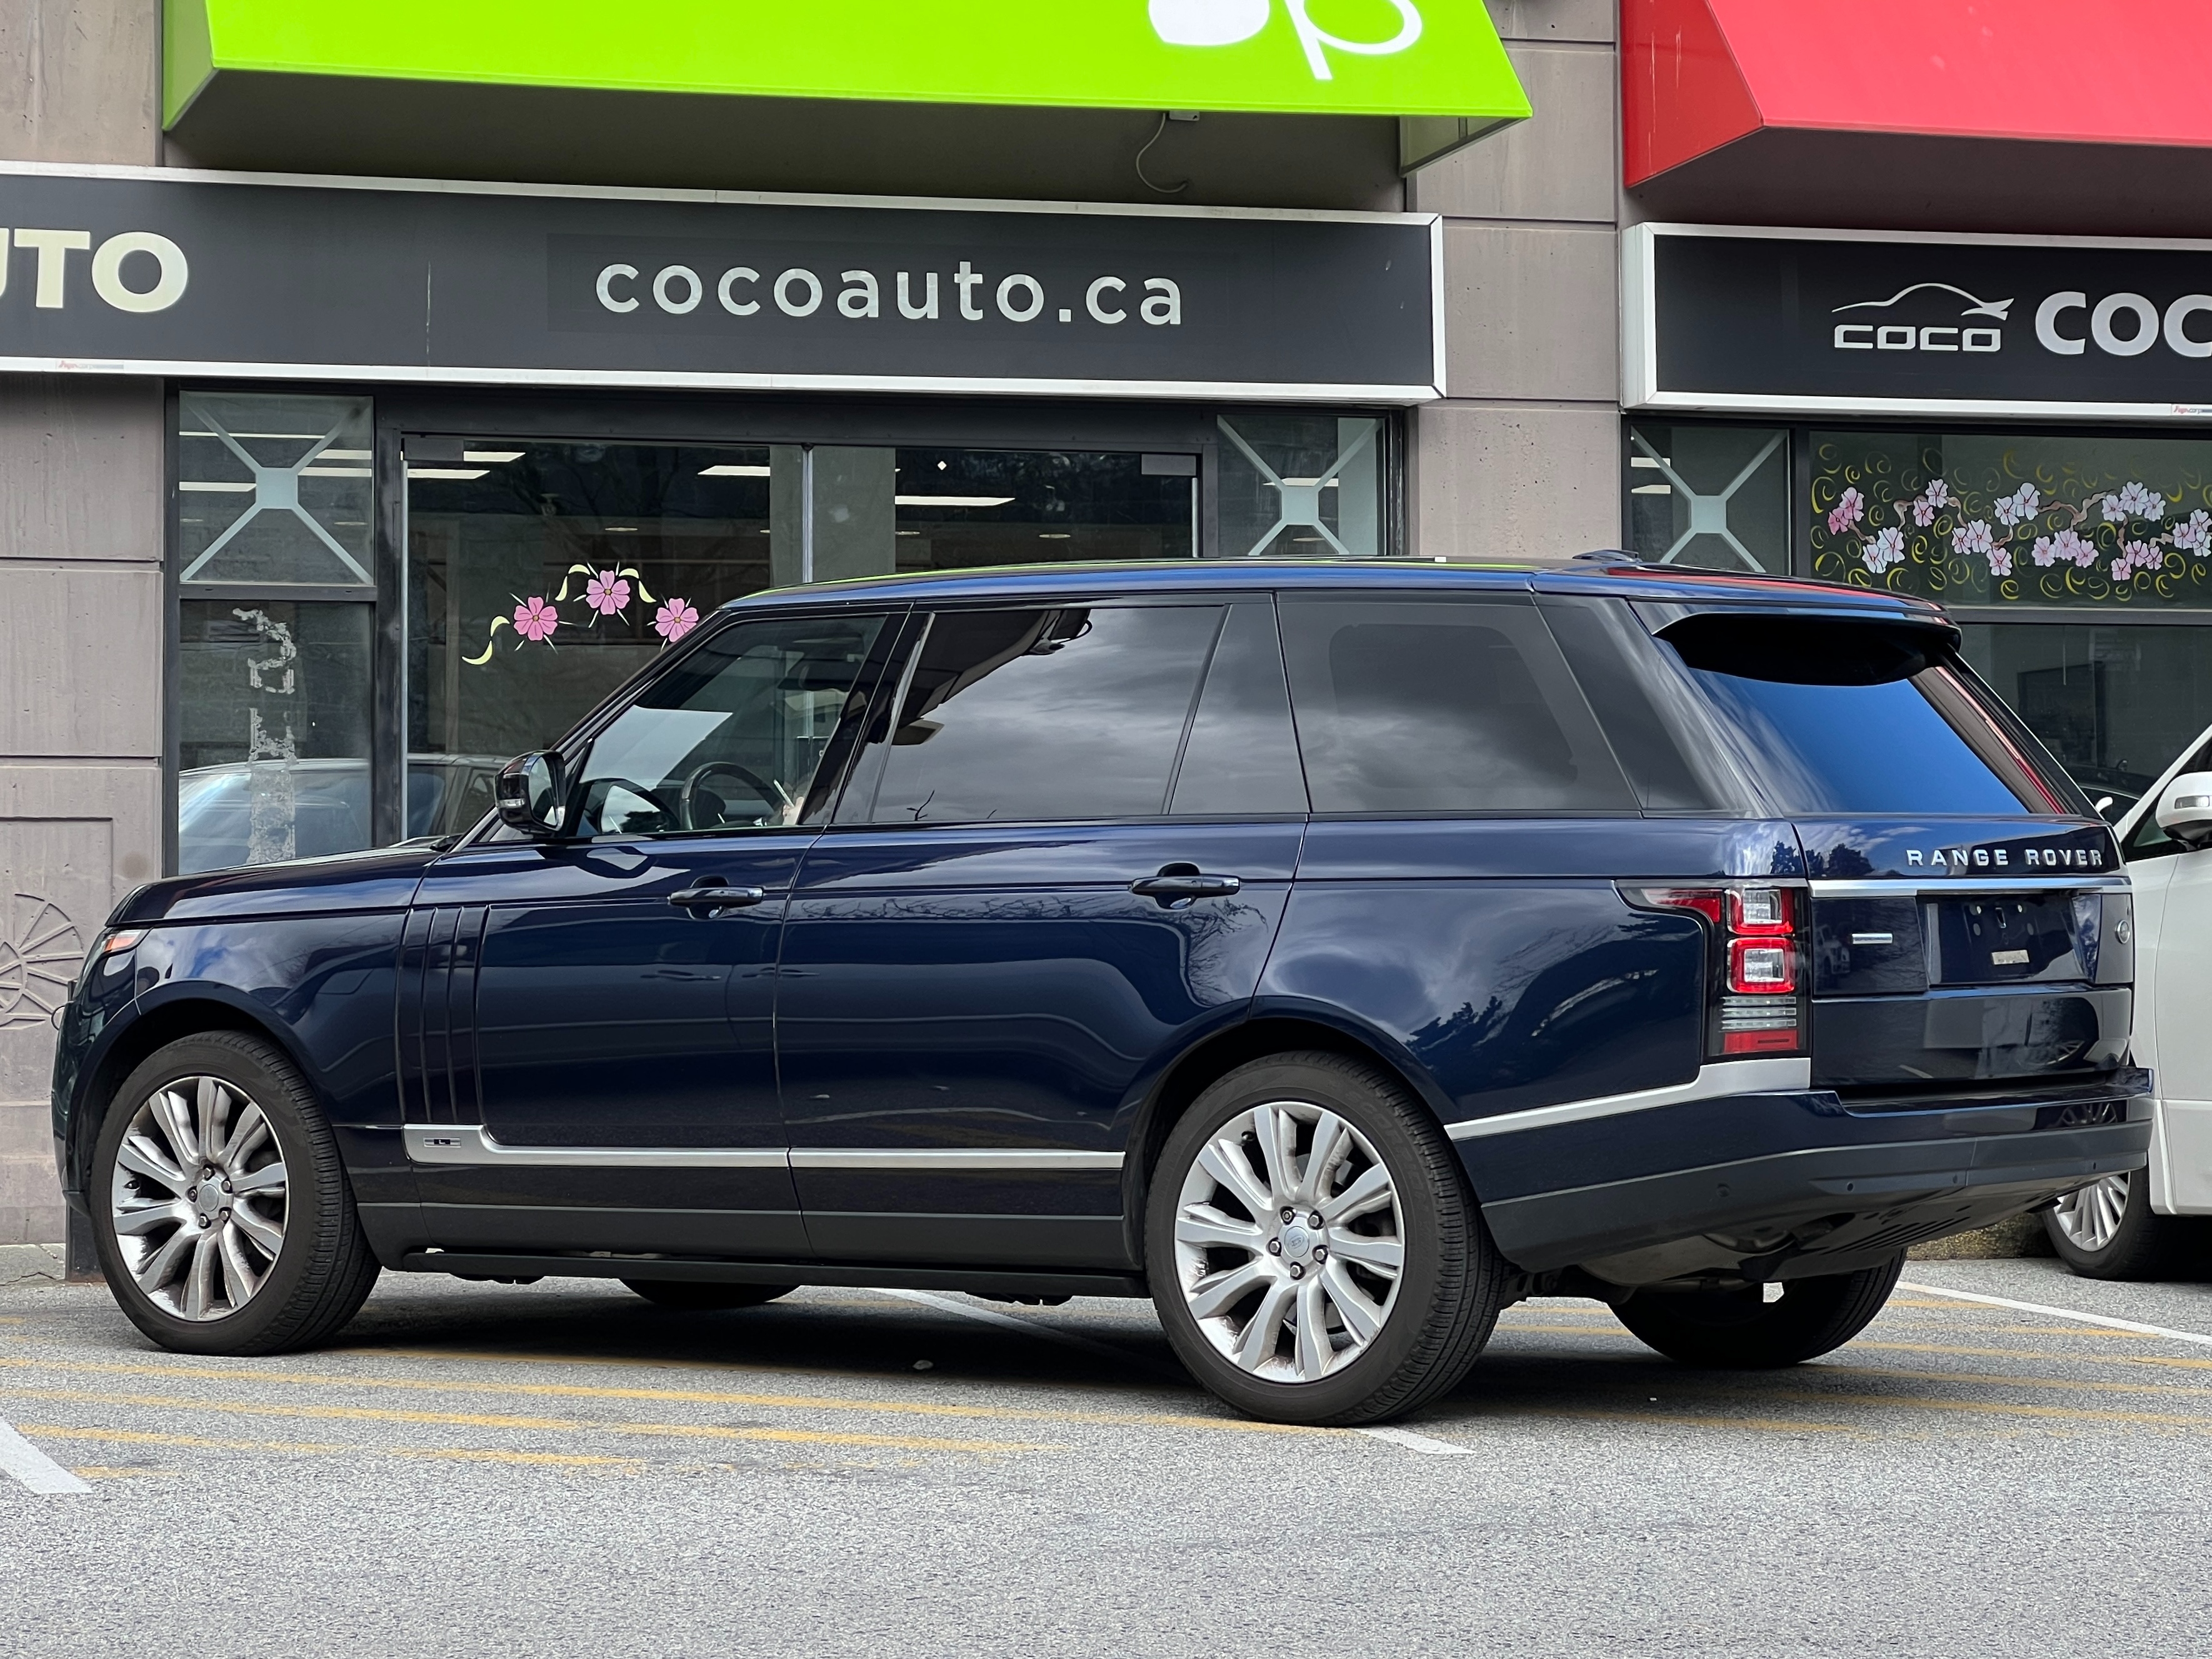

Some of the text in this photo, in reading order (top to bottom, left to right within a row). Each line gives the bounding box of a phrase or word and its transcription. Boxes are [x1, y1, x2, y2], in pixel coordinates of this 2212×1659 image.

[0, 228, 188, 313] TO
[595, 261, 1181, 325] cocoauto.ca
[1834, 324, 2001, 353] COCO
[2034, 291, 2212, 358] COC
[1906, 849, 2103, 867] RANGE ROVER
